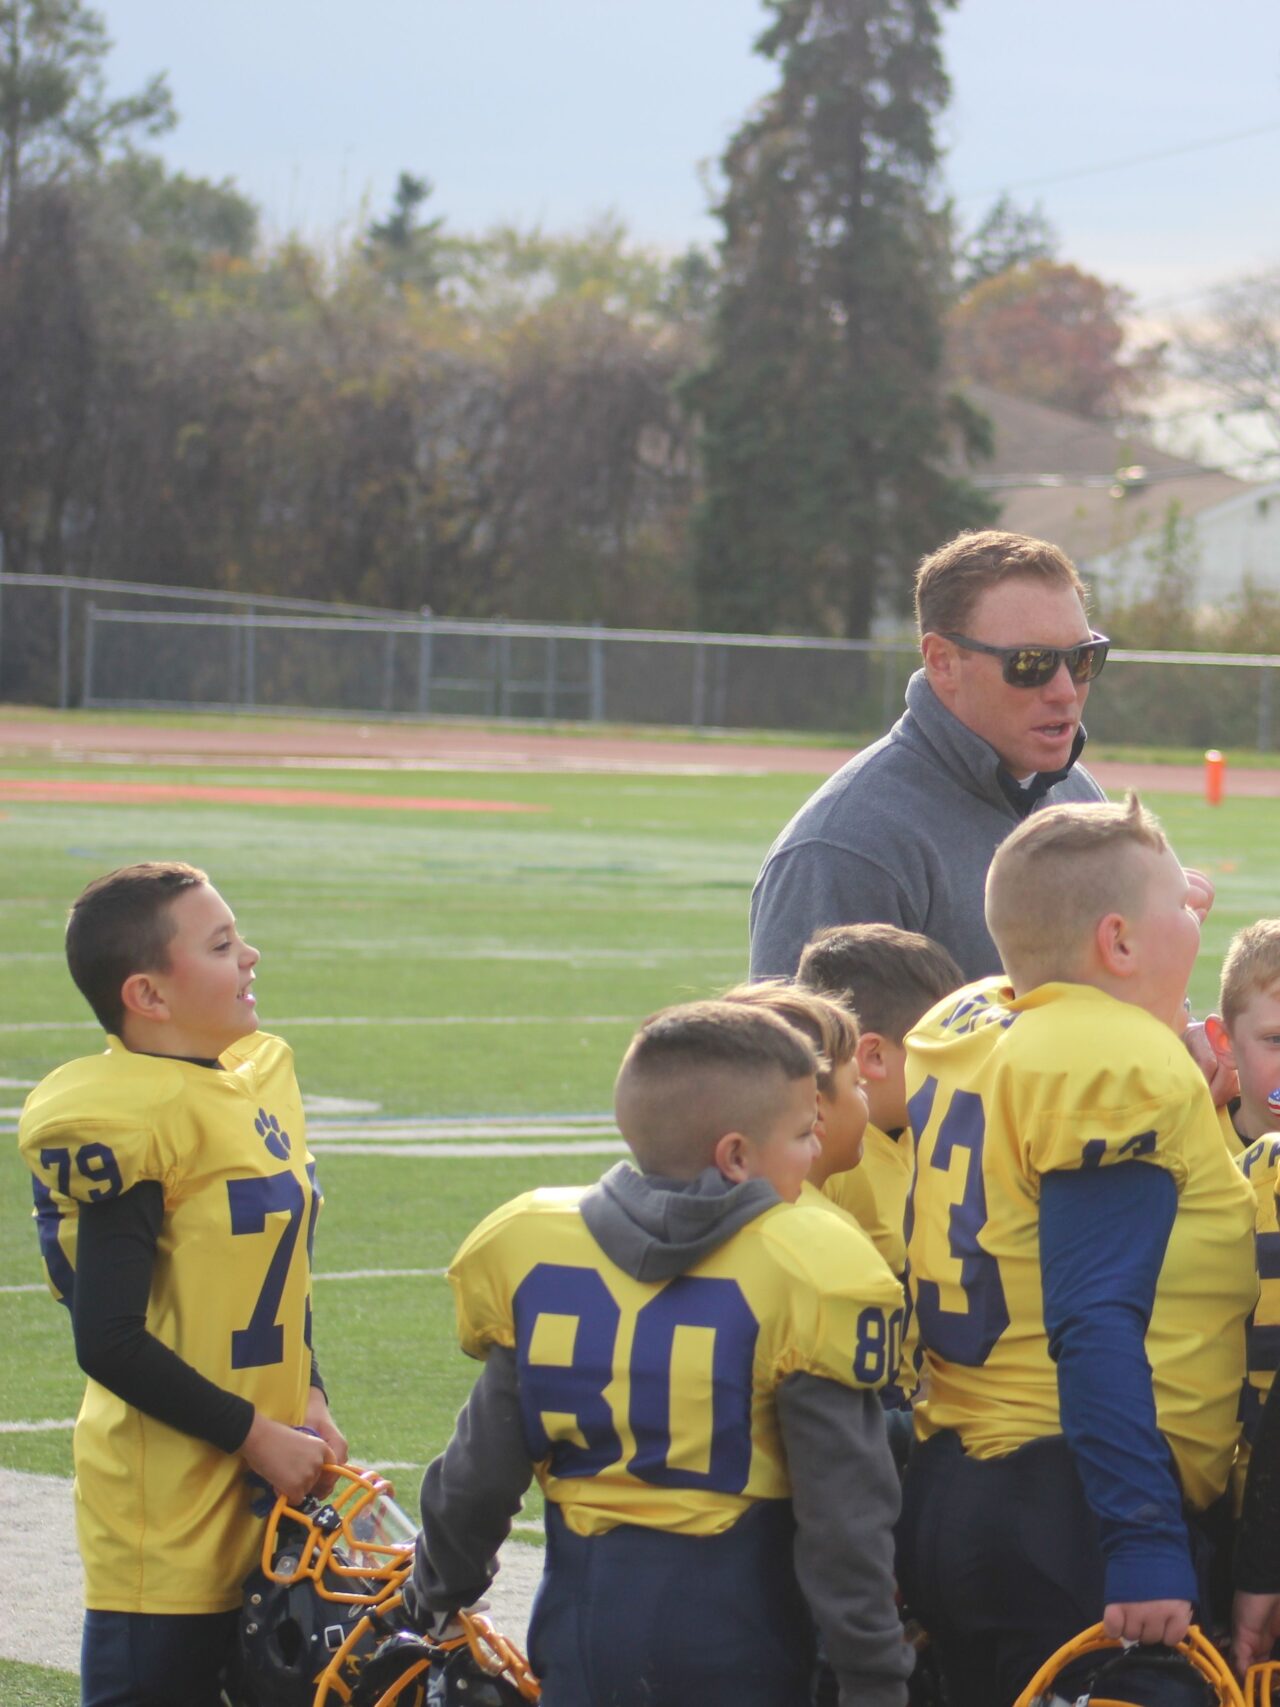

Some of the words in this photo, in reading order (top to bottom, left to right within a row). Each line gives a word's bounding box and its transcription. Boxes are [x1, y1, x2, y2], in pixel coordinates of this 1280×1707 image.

[40, 1142, 123, 1201] 79
[227, 1162, 322, 1369] 7
[512, 1262, 760, 1495] 80
[852, 1307, 905, 1384] 80
